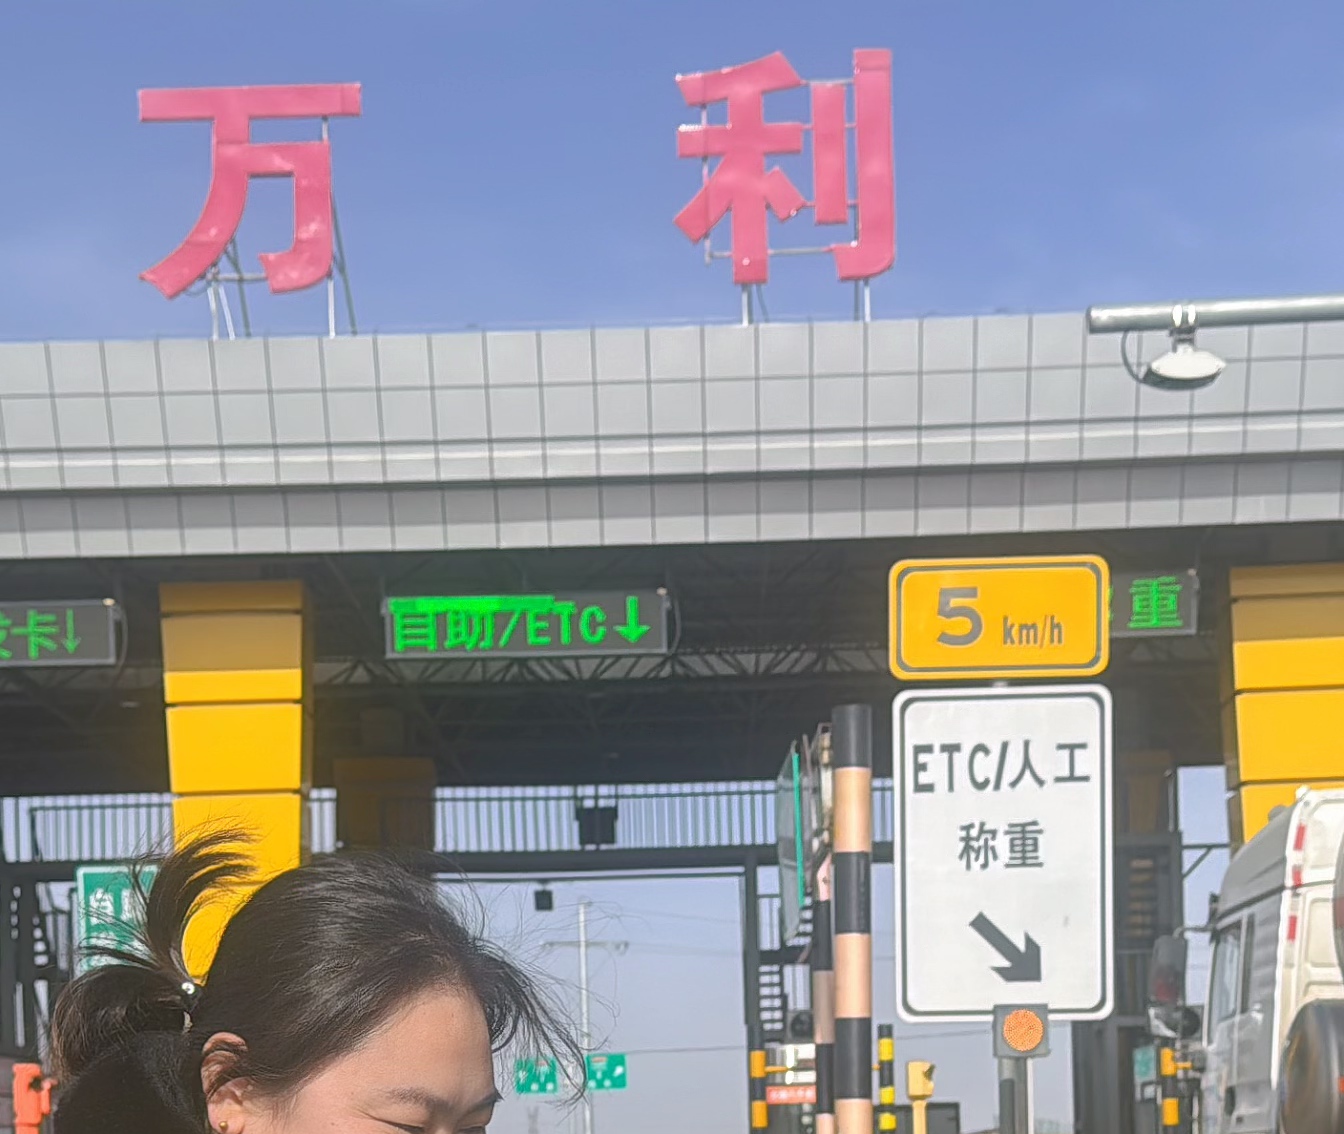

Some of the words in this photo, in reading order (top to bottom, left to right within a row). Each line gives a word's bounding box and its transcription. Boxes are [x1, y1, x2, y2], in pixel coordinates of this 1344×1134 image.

[936, 586, 983, 646] 5
[1003, 614, 1064, 649] km/h
[913, 739, 1091, 793] ETC/人工
[958, 820, 1044, 871] 称重
